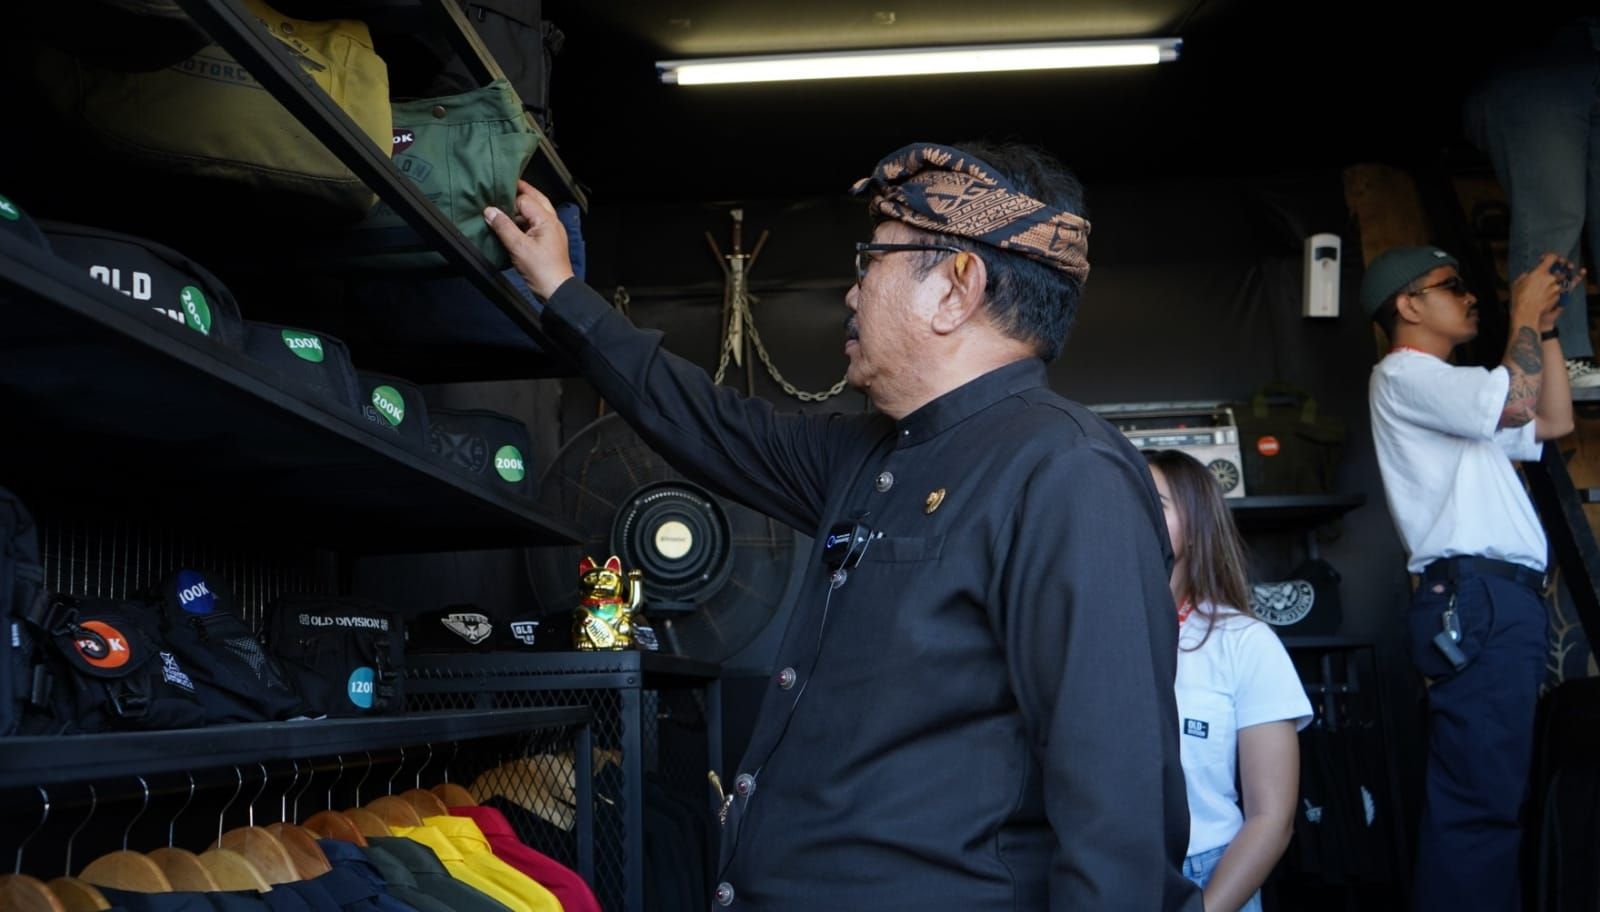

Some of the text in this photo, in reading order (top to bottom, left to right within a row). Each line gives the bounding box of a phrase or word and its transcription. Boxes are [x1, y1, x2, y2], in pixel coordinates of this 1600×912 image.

[178, 57, 249, 81] OTORC
[285, 337, 322, 350] 200K
[373, 392, 403, 420] 200K
[178, 581, 211, 605] 100K
[311, 617, 380, 629] OLD DIVISION
